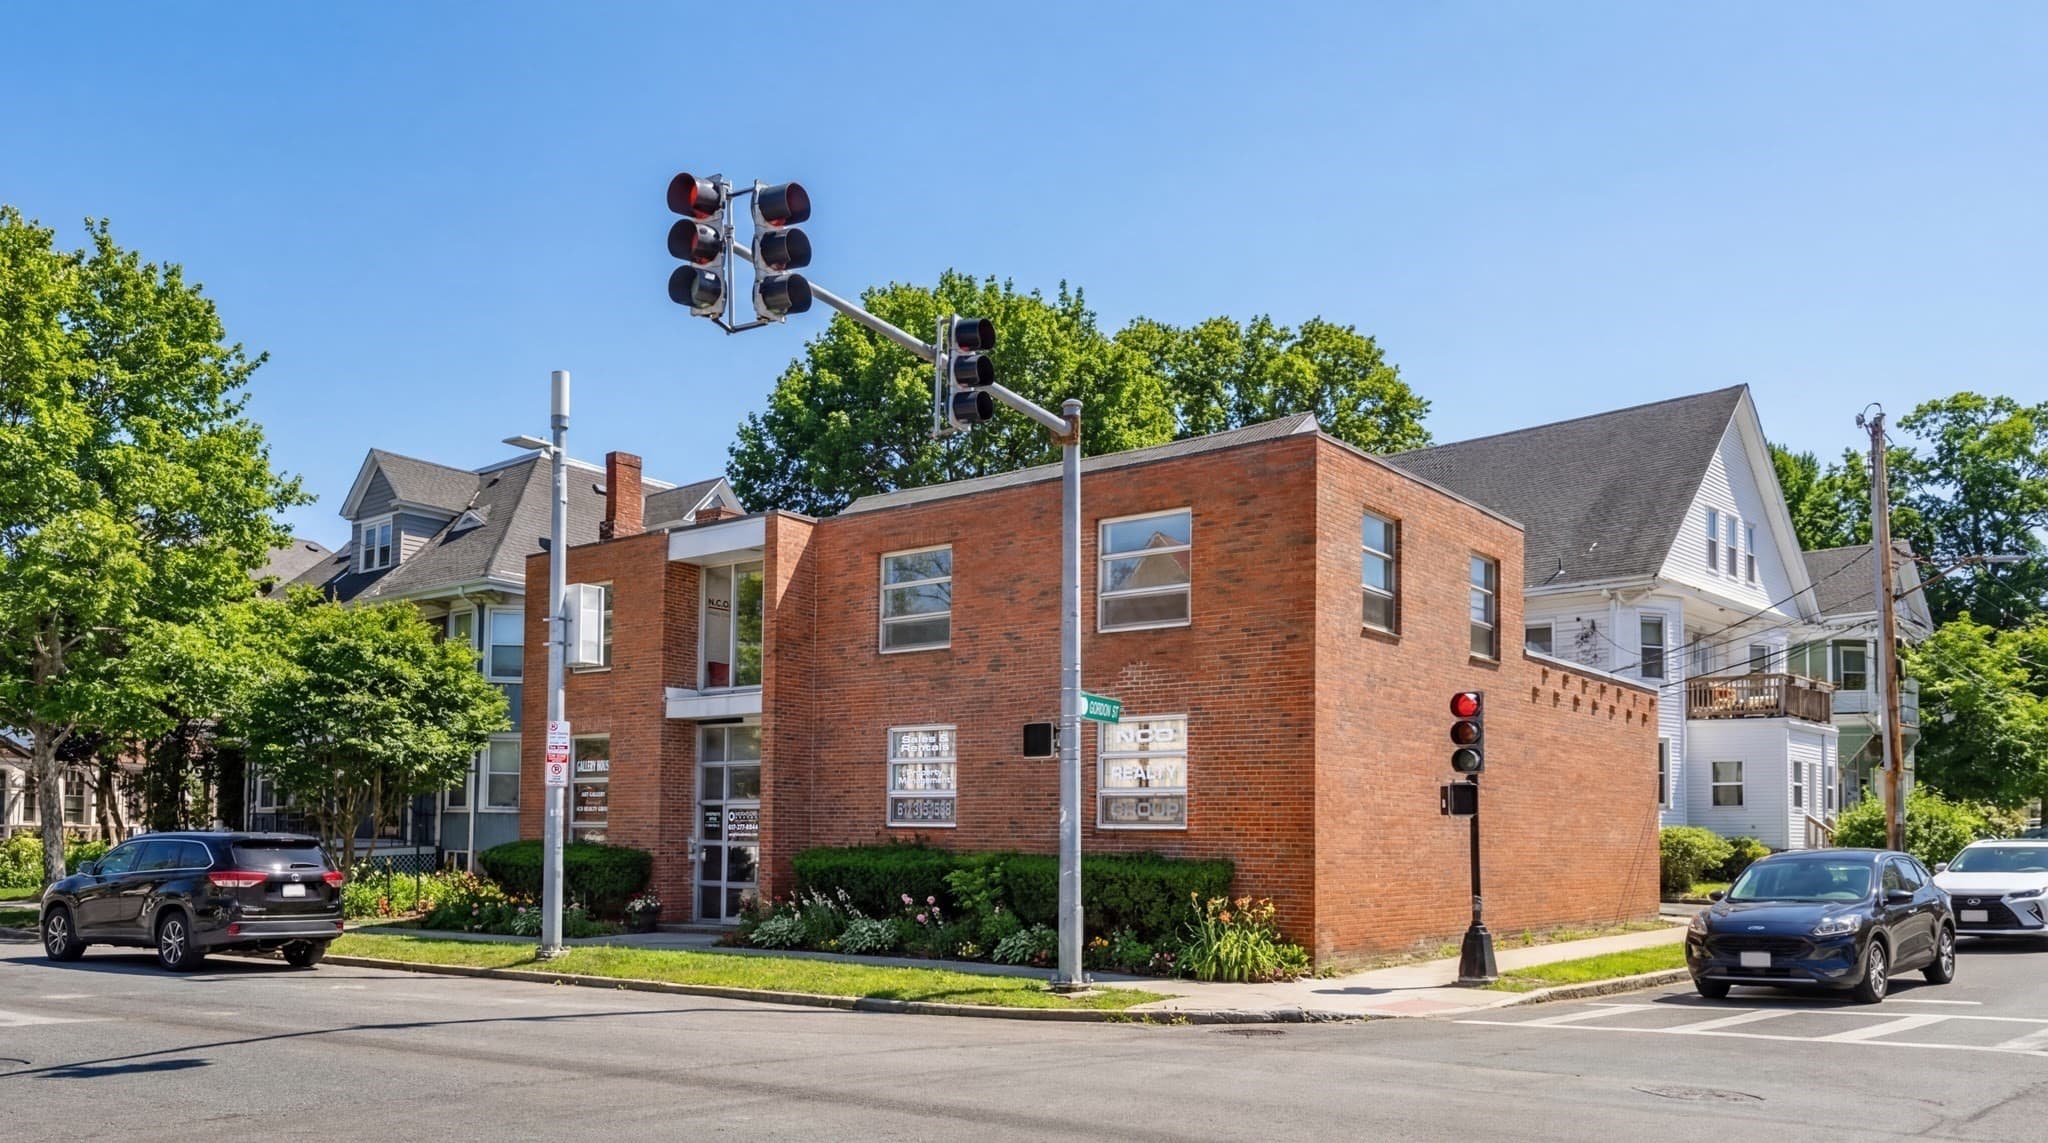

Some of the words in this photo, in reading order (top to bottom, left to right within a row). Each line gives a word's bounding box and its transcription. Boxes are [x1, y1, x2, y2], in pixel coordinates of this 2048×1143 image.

[1089, 701, 1111, 716] GORDON
[1112, 704, 1120, 718] ST
[901, 733, 936, 743] Sales
[939, 734, 949, 742] &
[1116, 728, 1175, 743] NCO
[901, 743, 950, 752] Rentals
[576, 760, 596, 772] GALLERY
[1111, 764, 1177, 780] REALTY
[906, 768, 943, 778] Property
[898, 777, 952, 786] Management
[1111, 802, 1179, 817] GROUP
